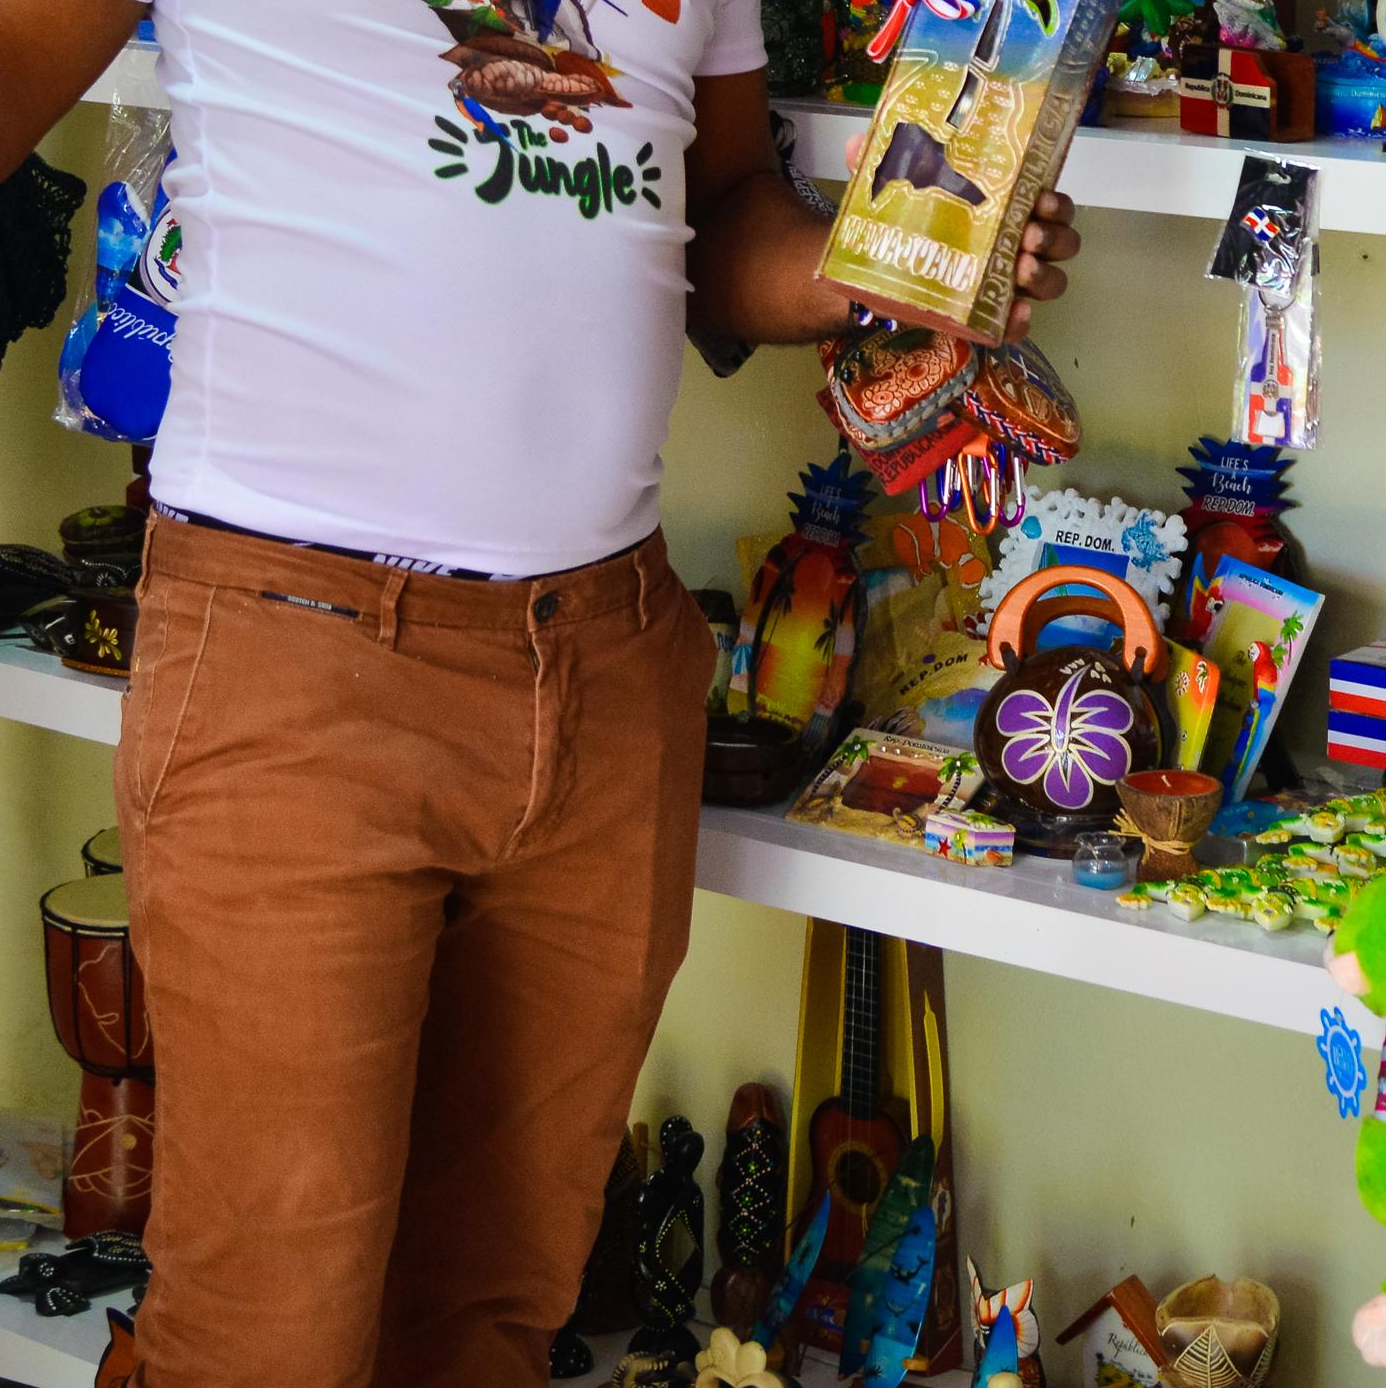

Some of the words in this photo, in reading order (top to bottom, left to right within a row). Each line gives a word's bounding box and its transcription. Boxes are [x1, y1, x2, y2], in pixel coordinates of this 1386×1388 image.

[510, 119, 548, 151] The
[474, 121, 638, 220] Jungle
[1212, 470, 1254, 495] Beach
[1055, 529, 1083, 547] REP.
[1084, 534, 1115, 553] DOM.
